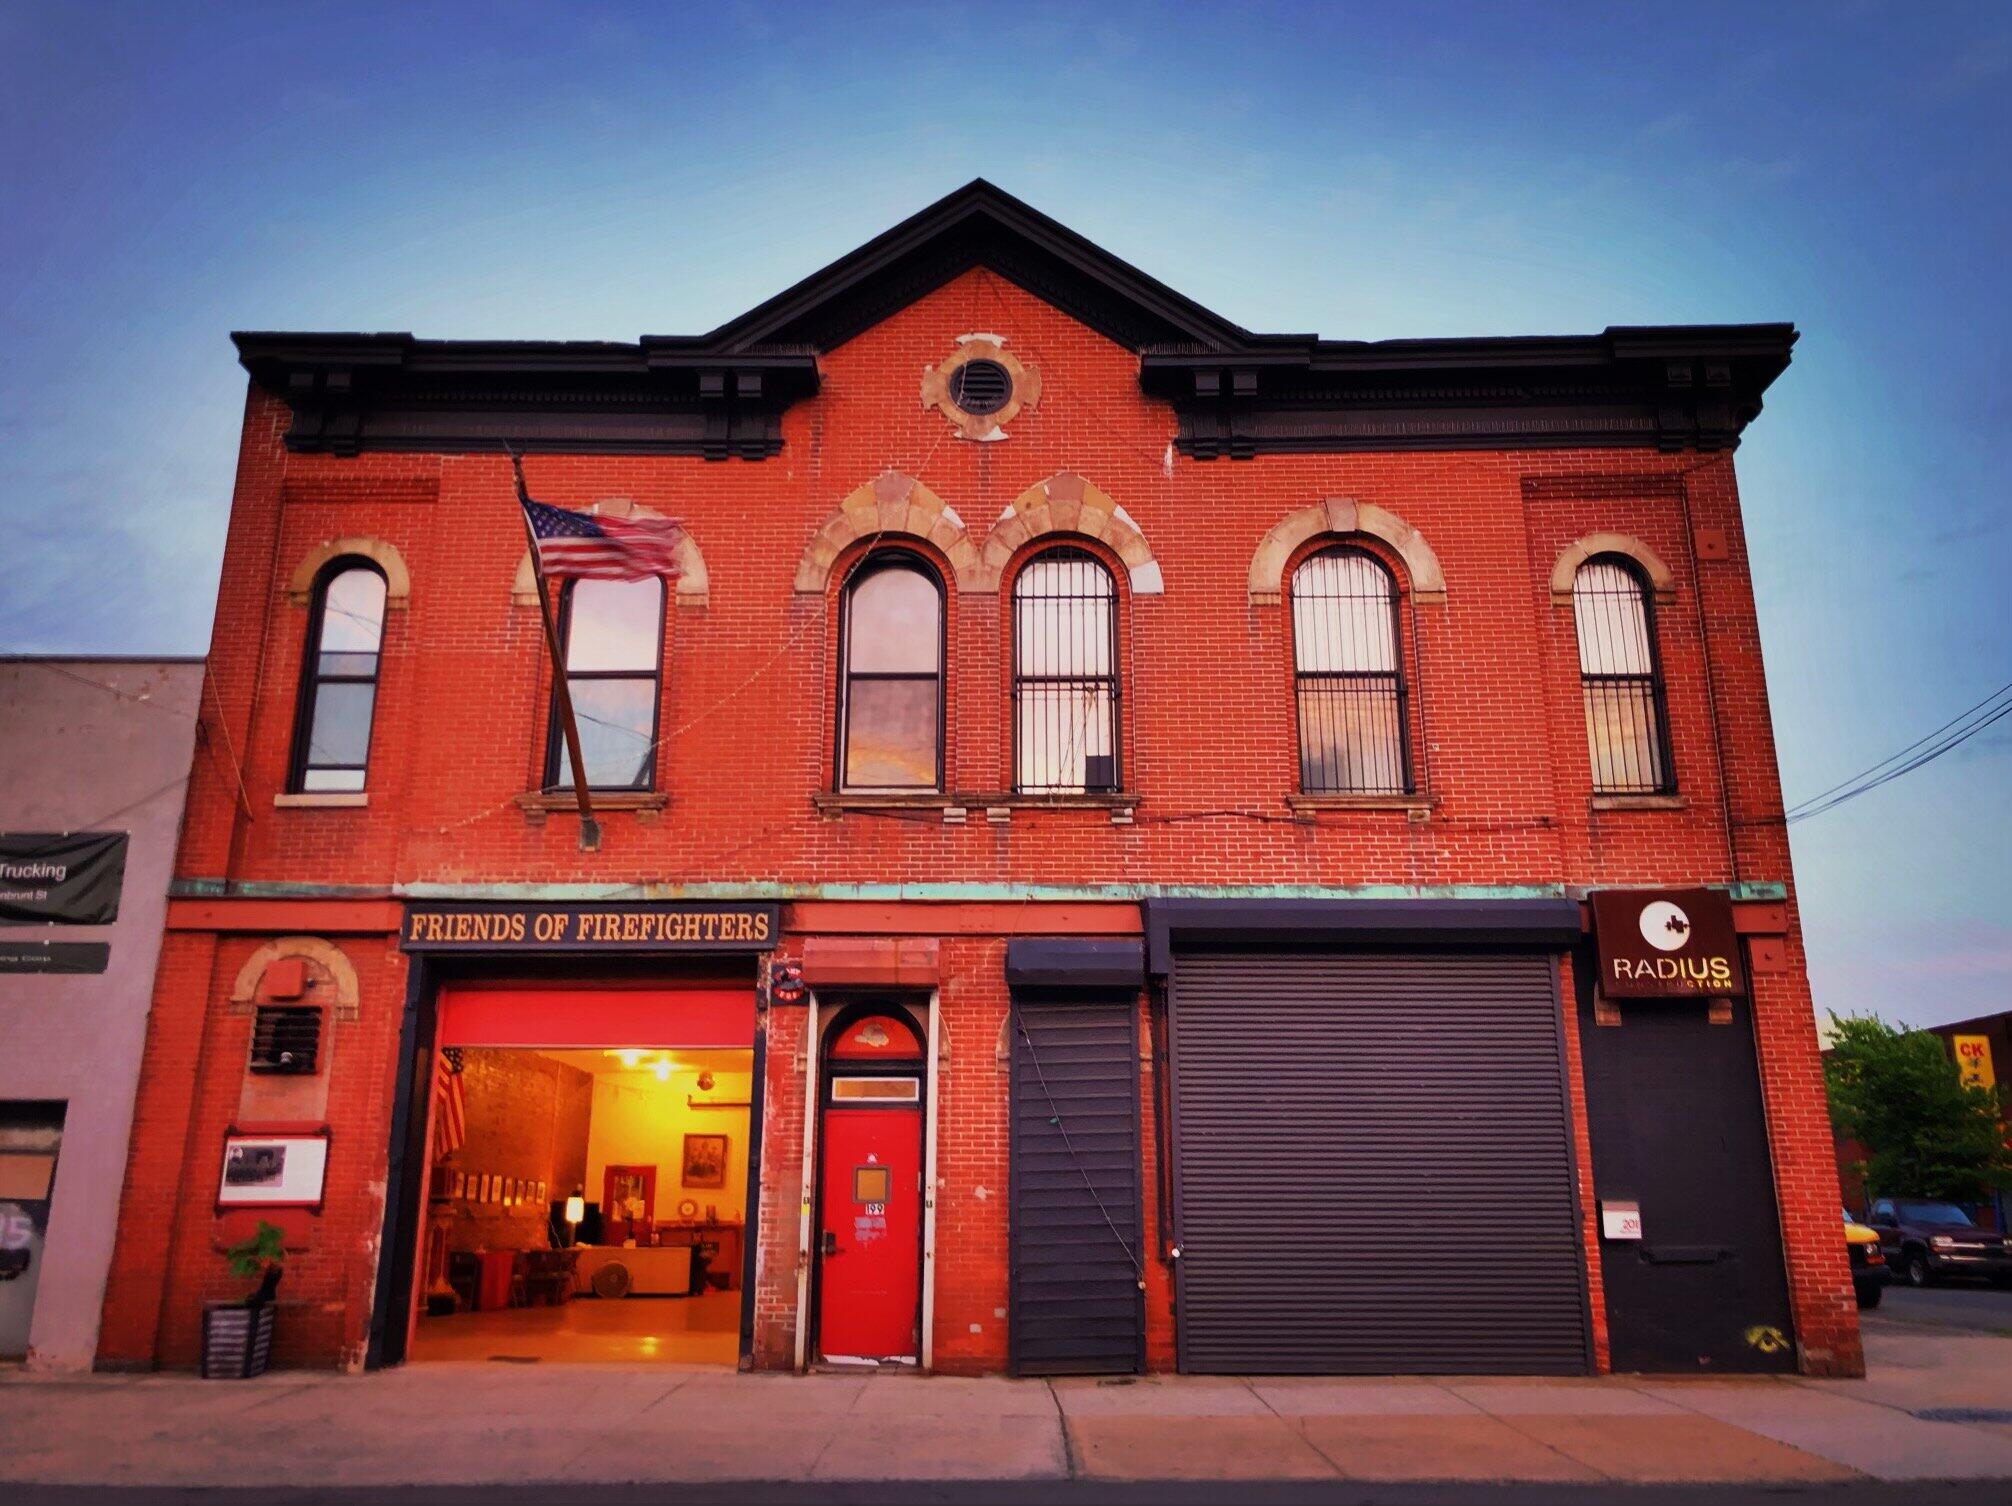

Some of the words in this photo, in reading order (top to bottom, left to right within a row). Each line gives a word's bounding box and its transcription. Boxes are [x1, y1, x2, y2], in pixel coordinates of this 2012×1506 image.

[0, 863, 66, 882] Trucking
[409, 913, 526, 941] FRIENDS
[534, 914, 569, 941] OF
[576, 913, 770, 941] FIREFIGHTERS
[1613, 957, 1731, 979] RADIUS
[1960, 1043, 1984, 1057] CK
